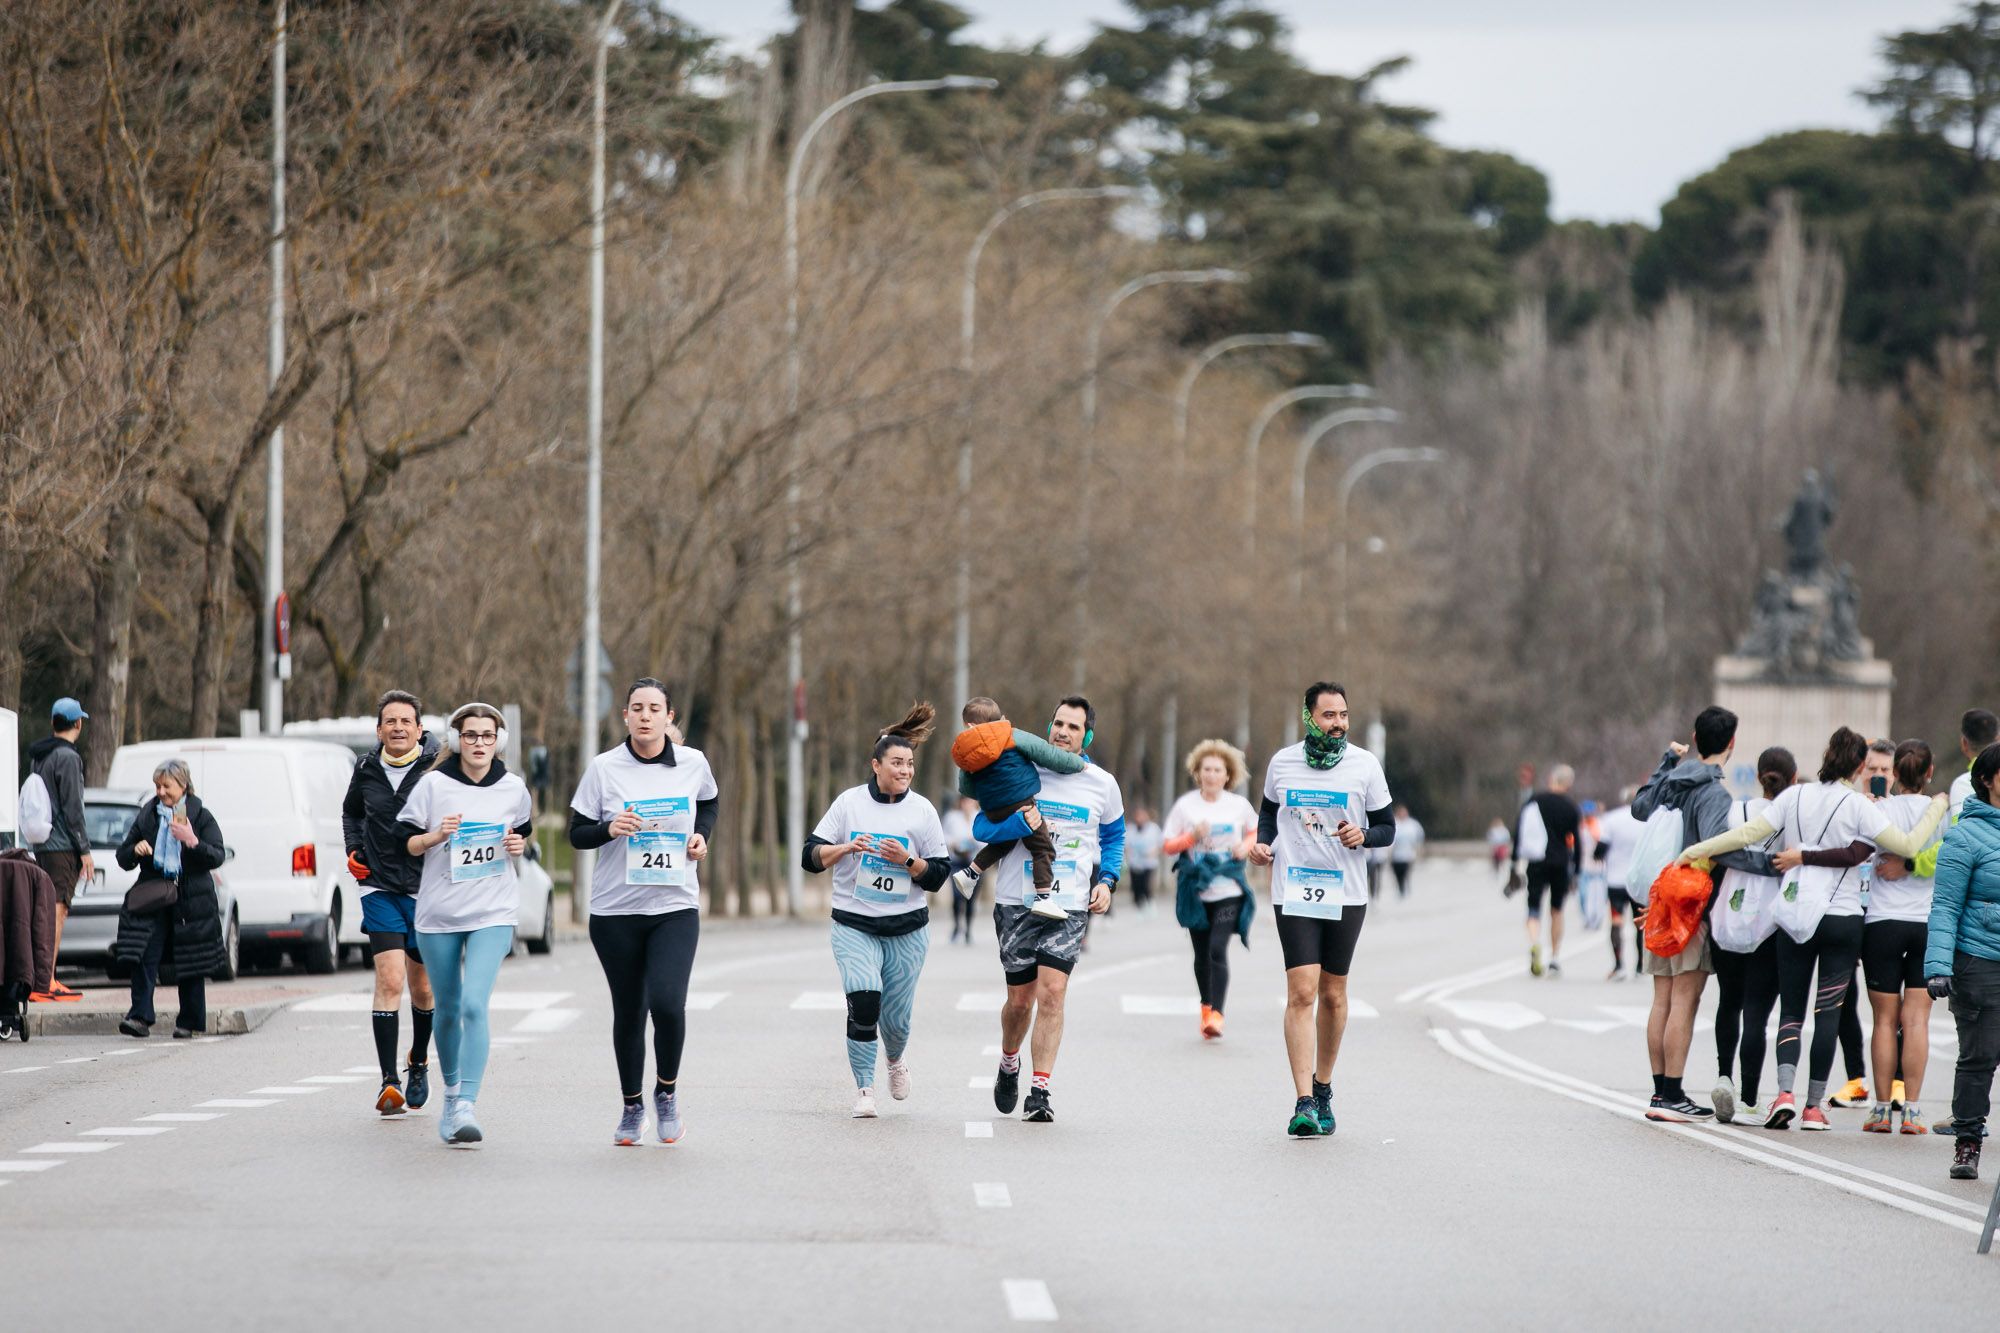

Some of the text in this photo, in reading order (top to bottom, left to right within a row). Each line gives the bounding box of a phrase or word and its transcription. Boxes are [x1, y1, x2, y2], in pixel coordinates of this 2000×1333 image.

[462, 846, 495, 865] 240
[642, 853, 672, 869] 241
[872, 876, 894, 892] 40
[1051, 879, 1061, 893] 4
[1303, 887, 1325, 902] 39
